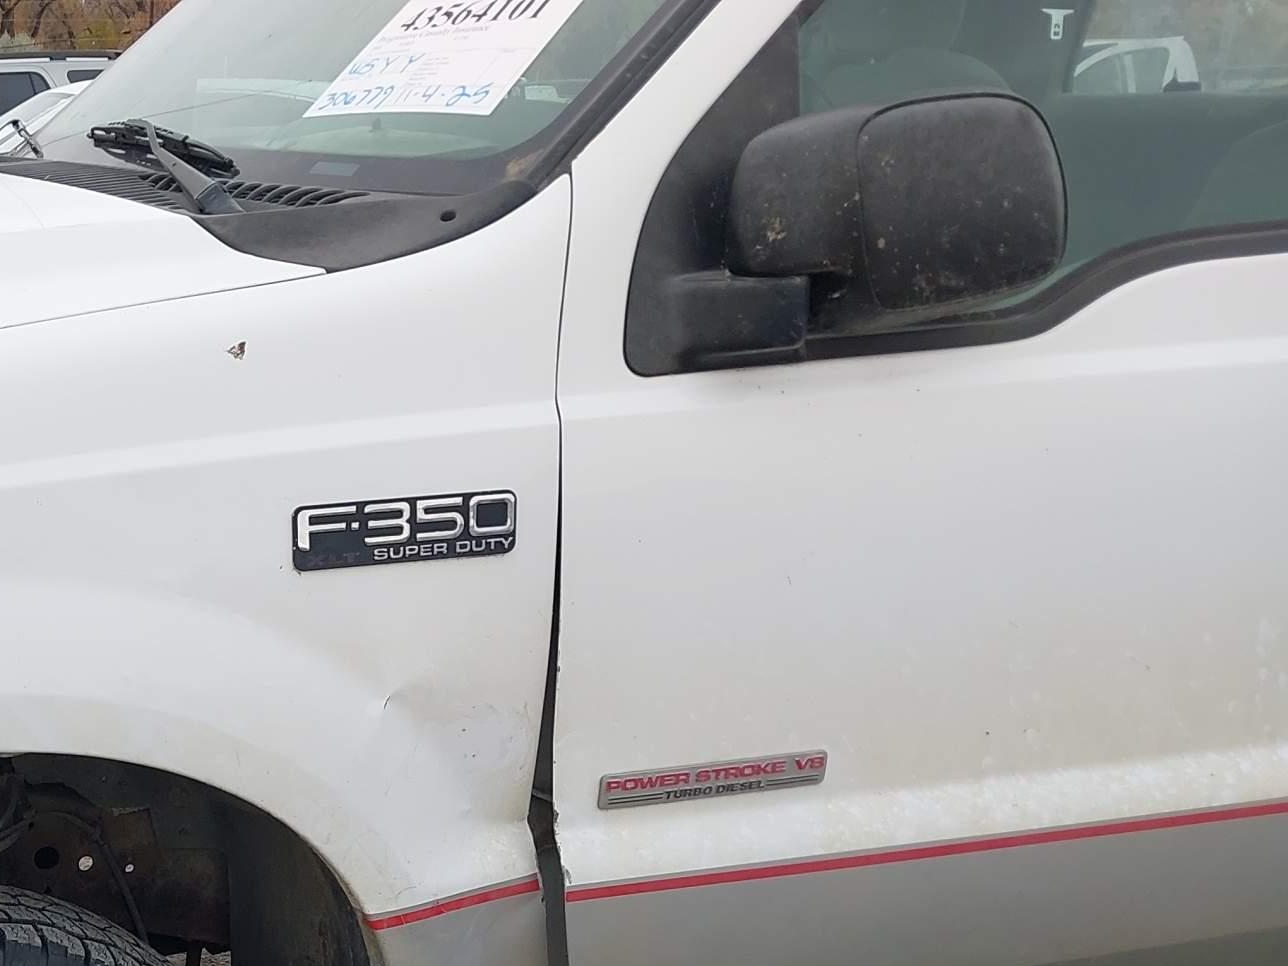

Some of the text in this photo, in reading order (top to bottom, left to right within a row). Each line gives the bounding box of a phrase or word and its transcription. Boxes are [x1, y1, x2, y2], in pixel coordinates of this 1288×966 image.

[401, 0, 553, 31] 43564101
[373, 536, 513, 561] SUPER DUTY
[605, 754, 826, 793] POWER STROKE V8
[663, 780, 766, 800] TURBO DIESEL
